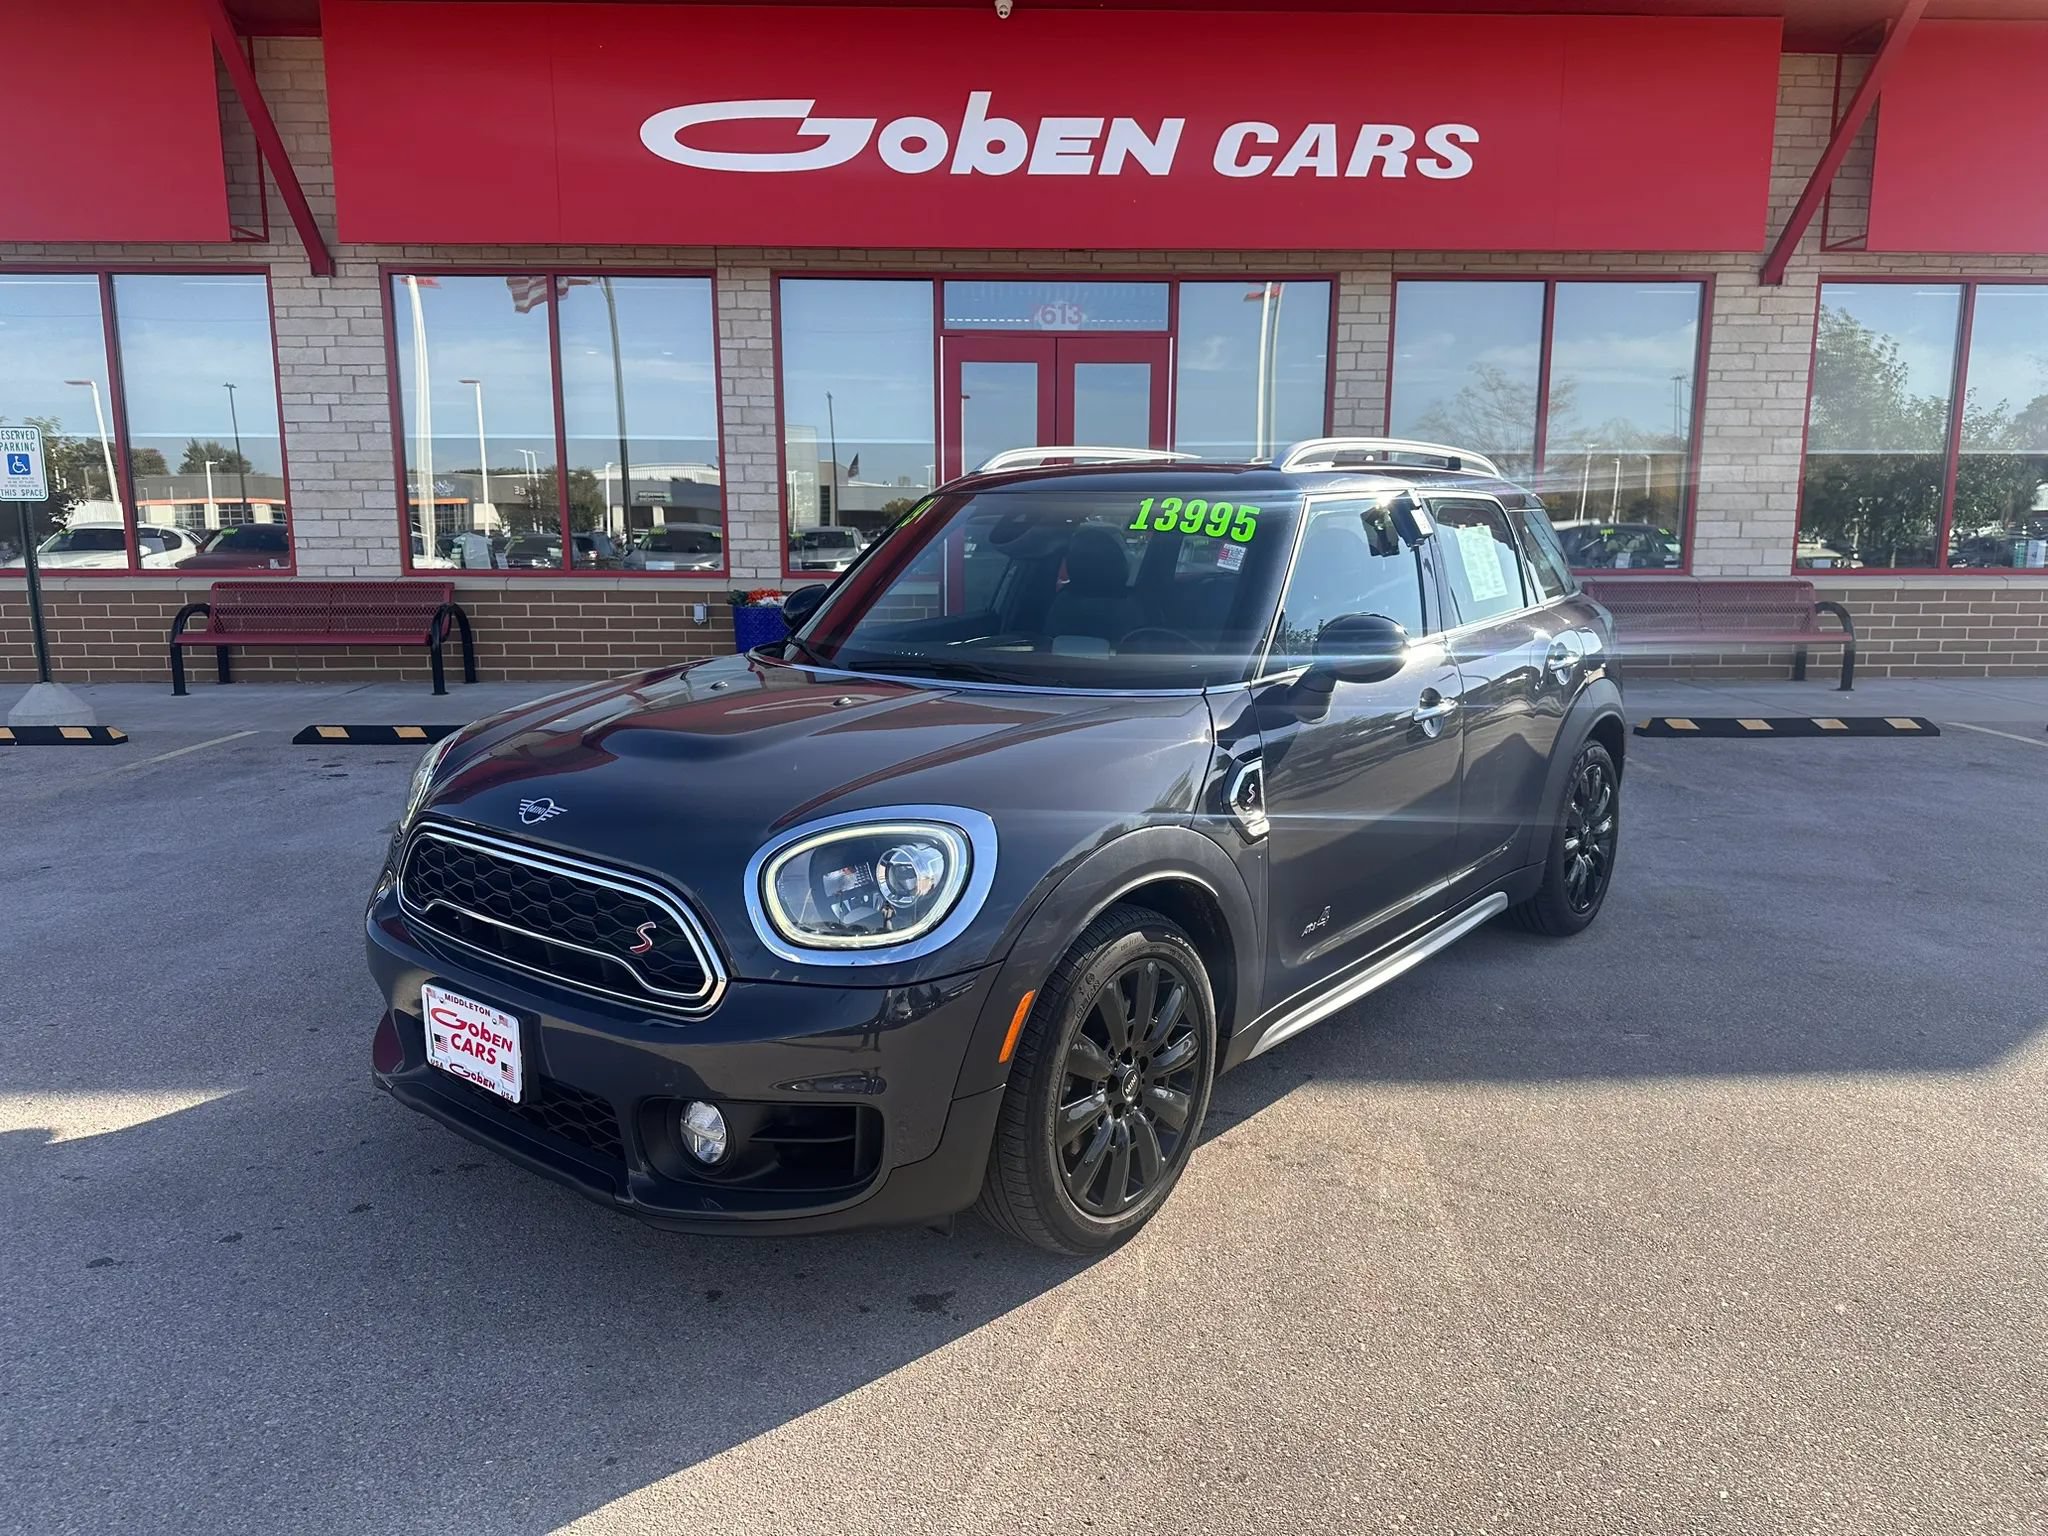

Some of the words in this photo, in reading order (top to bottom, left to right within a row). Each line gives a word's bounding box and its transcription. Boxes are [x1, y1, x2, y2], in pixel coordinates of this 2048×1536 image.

[1213, 121, 1479, 180] CARS
[0, 430, 35, 441] ESERVED
[0, 442, 35, 452] PARKING
[1, 489, 17, 497] THIS
[21, 489, 44, 497] SPACE
[1129, 497, 1261, 543] 13995
[629, 921, 657, 954] S
[444, 993, 491, 1017] MIDDLETON
[451, 1033, 497, 1065] CARS
[430, 1059, 444, 1069] USA
[501, 1090, 515, 1101] USA
[1124, 1074, 1138, 1095] MINI
